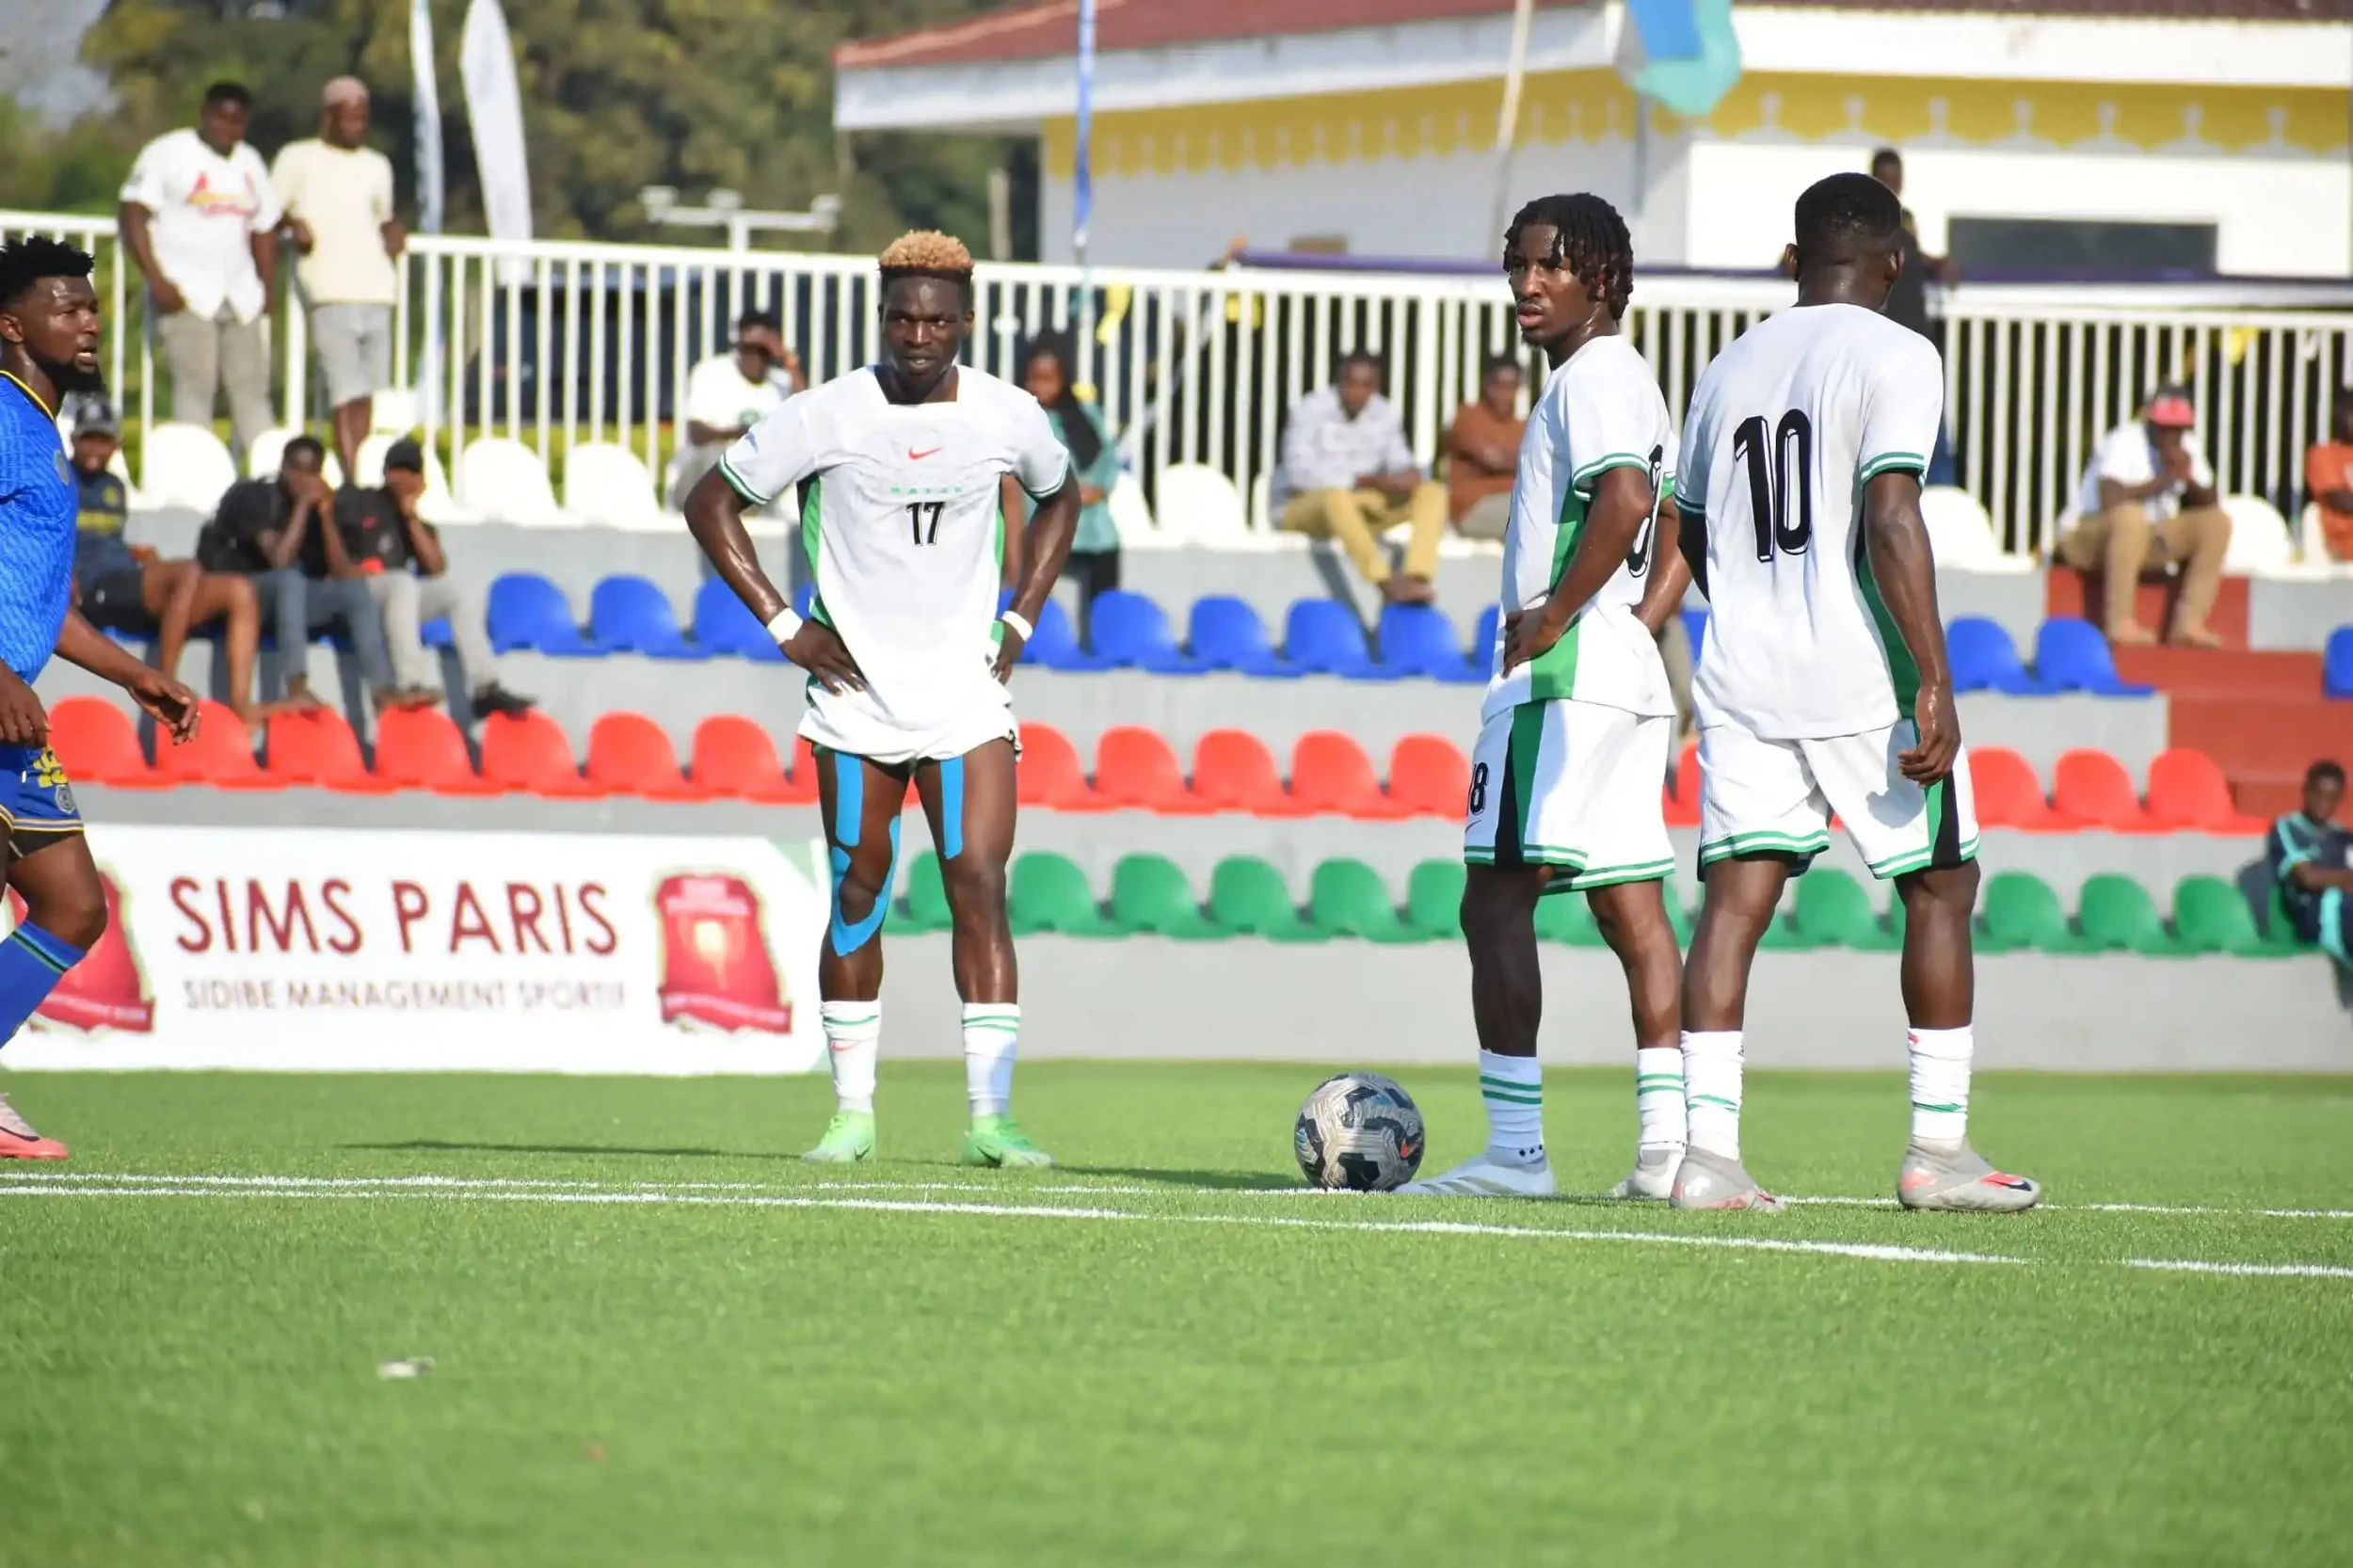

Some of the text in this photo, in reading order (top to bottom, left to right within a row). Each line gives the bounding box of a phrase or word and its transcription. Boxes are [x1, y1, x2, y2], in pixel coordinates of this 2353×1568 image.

[1734, 408, 1812, 563] 10
[905, 501, 946, 546] 17
[169, 875, 362, 954] SIMS
[392, 879, 618, 955] PARIS
[184, 979, 276, 1009] SIDIBE
[287, 980, 505, 1010] MANAGEMENT
